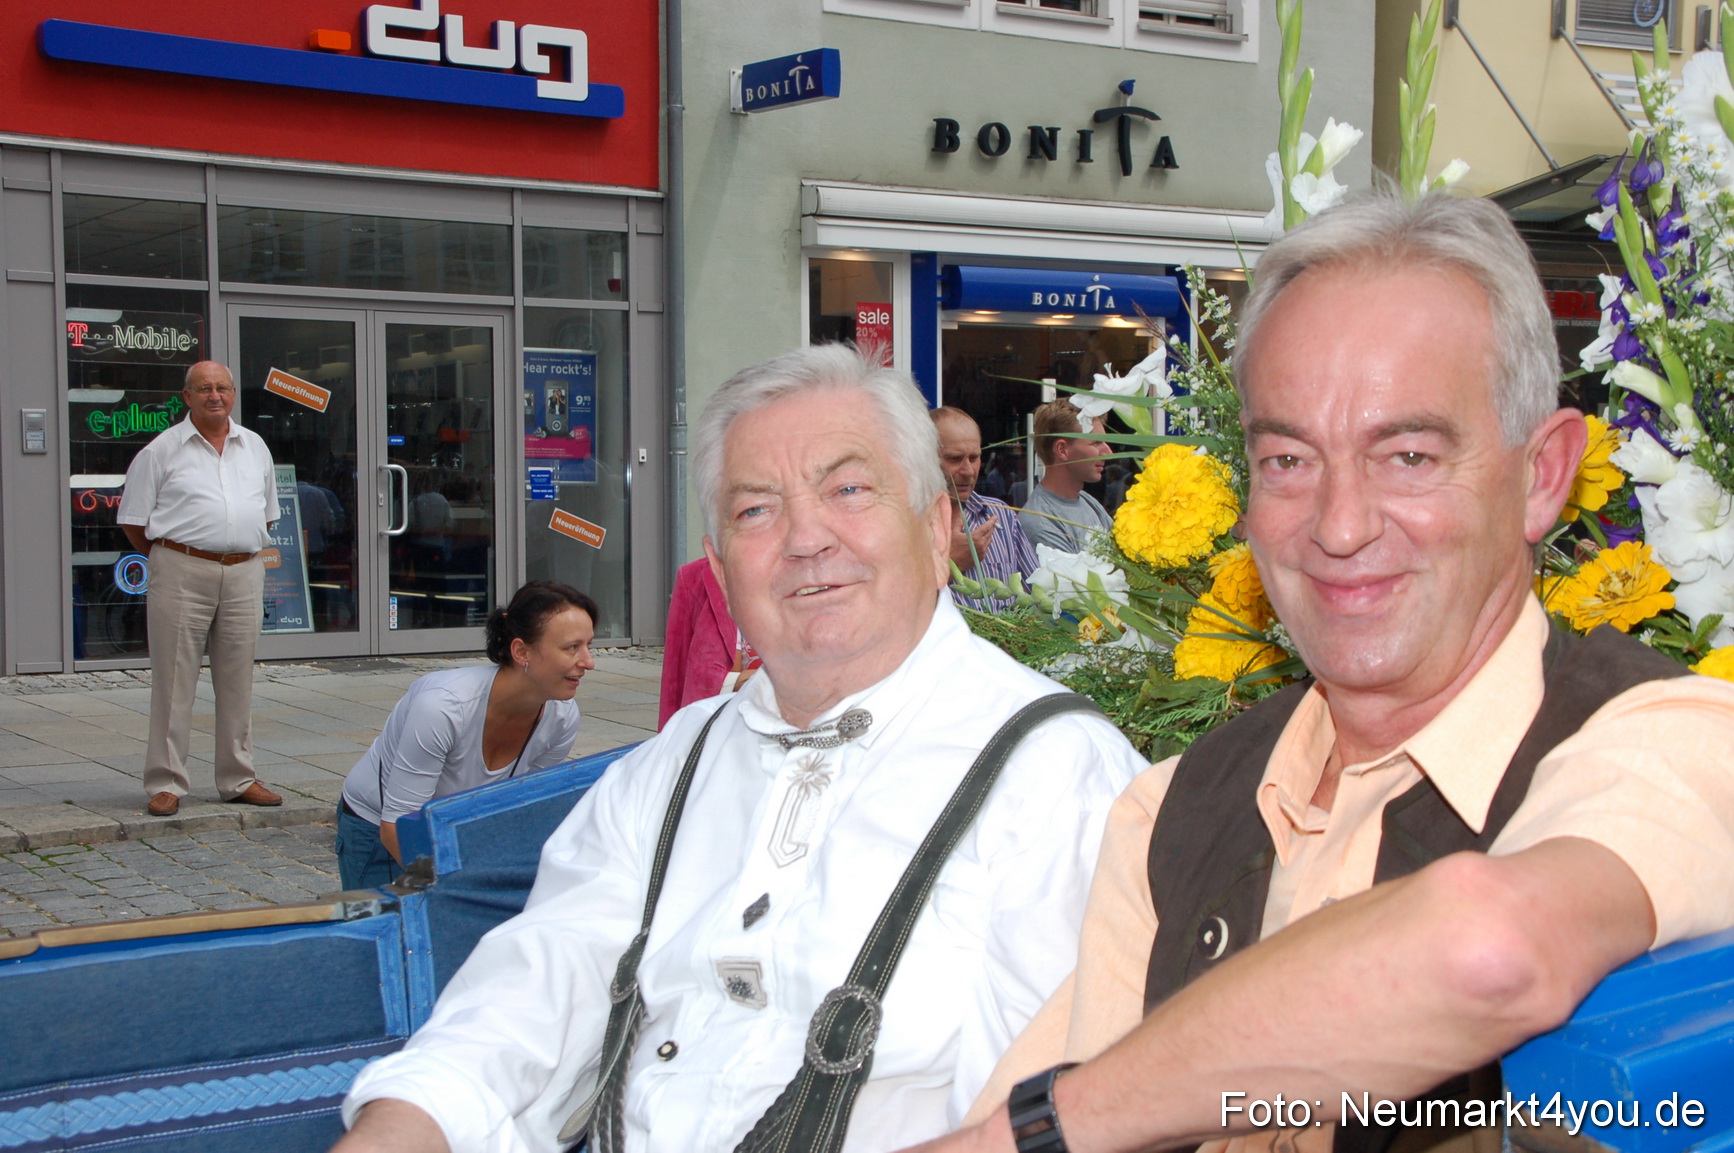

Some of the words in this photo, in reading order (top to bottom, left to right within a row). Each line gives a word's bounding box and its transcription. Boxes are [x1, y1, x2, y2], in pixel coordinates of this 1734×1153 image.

[745, 55, 816, 103] BONITA
[931, 79, 1180, 177] BONITA
[1032, 274, 1116, 312] BONITA
[858, 308, 890, 325] sale
[550, 363, 592, 375] rockt's!
[271, 376, 325, 406] Neueröffnung
[555, 516, 601, 542] Neueröffnung
